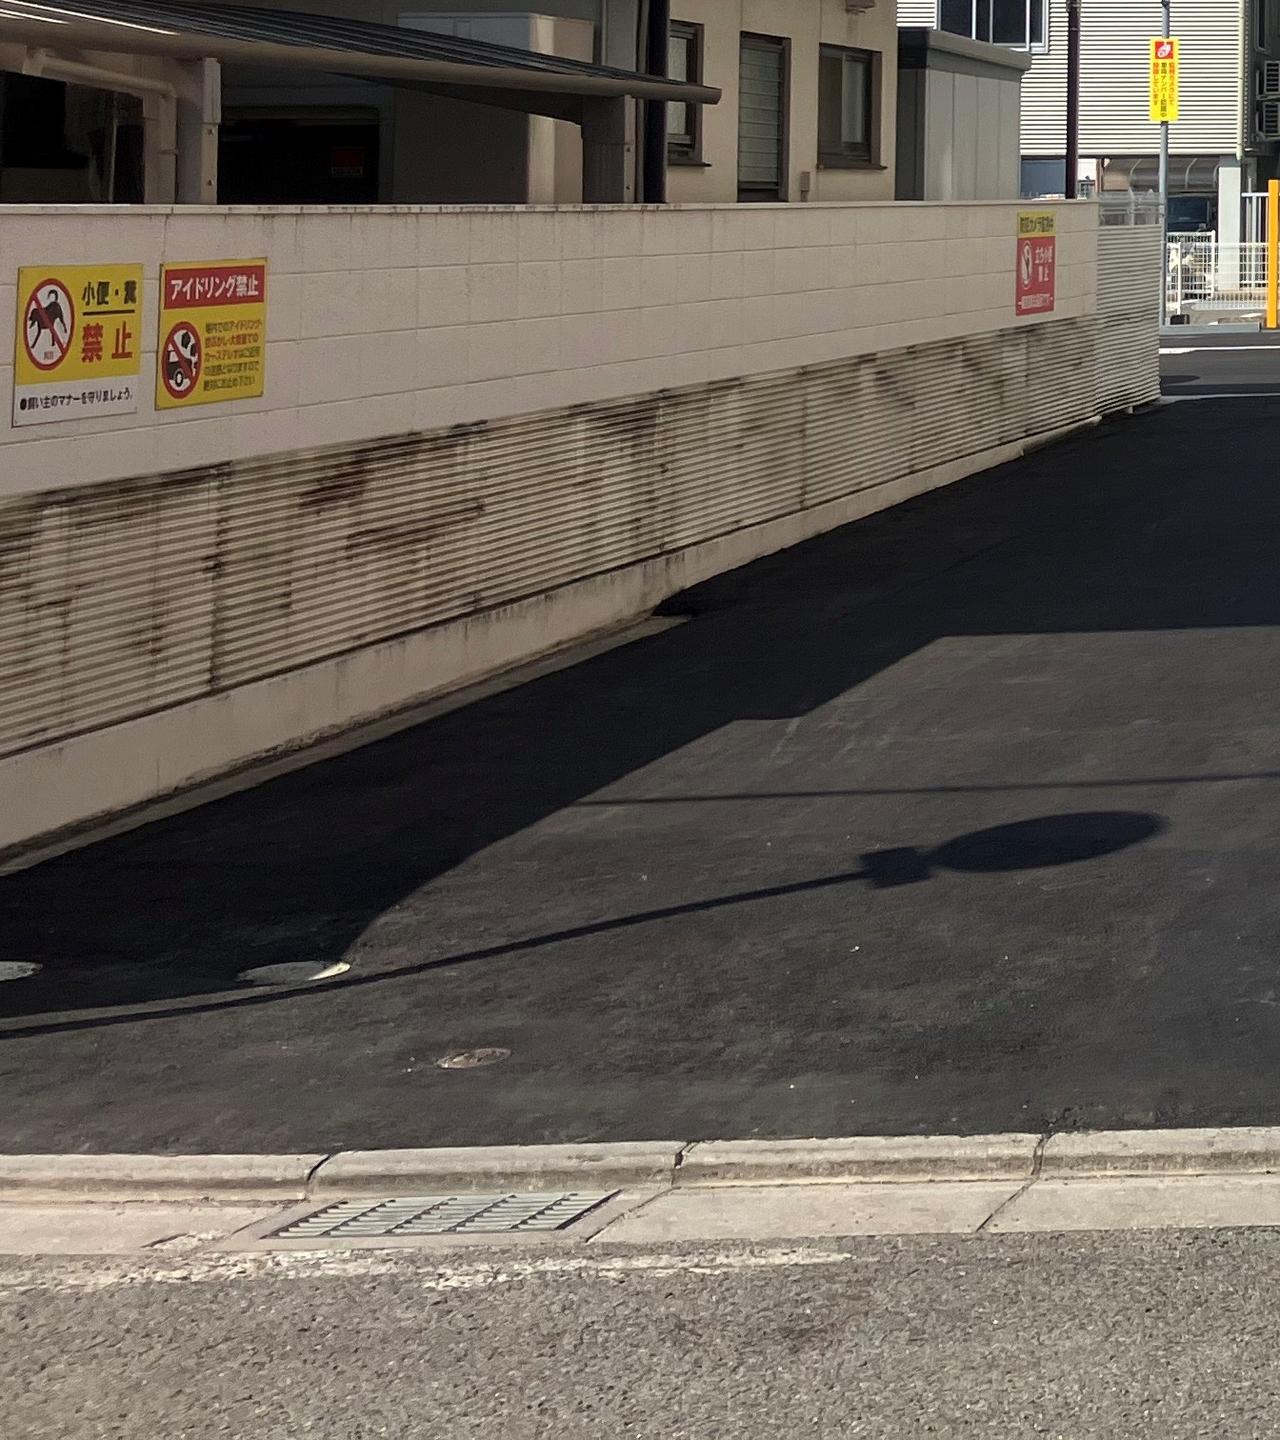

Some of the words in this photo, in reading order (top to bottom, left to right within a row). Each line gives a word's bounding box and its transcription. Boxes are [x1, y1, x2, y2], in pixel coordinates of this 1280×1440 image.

[170, 277, 259, 301] アイドリング禁止
[81, 320, 133, 363] 禁止
